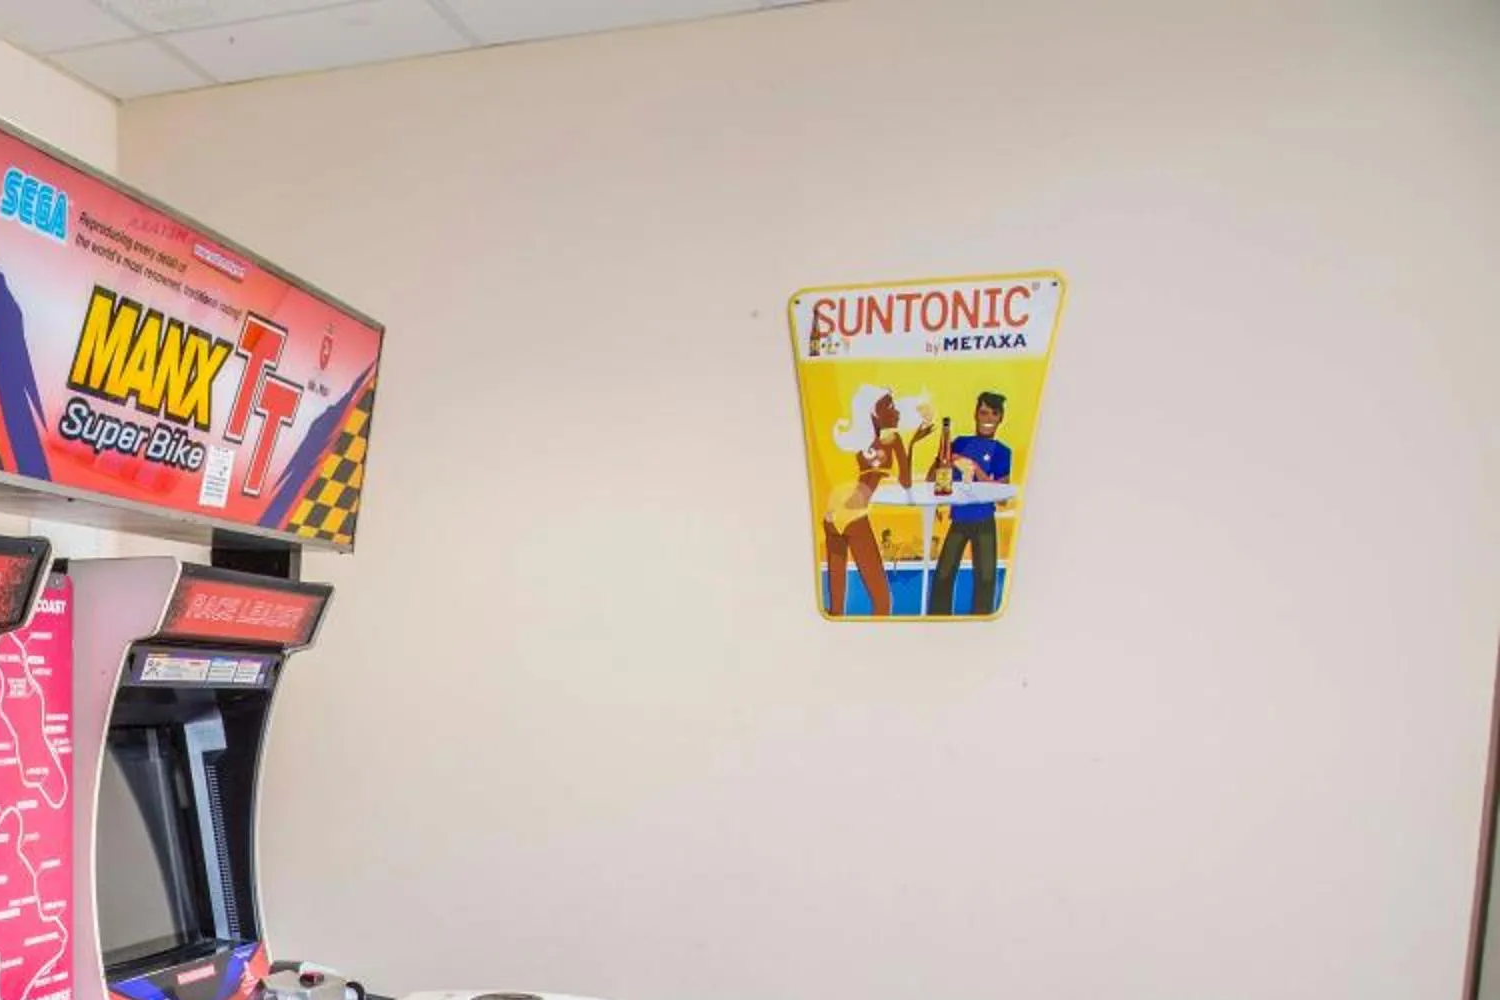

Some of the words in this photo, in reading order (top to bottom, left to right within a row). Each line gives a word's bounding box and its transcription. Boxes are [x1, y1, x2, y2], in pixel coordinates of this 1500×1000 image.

[0, 168, 70, 243] SEGA
[812, 285, 1032, 338] SUNTONIC
[943, 333, 1027, 352] METAXA
[67, 286, 231, 432] MANX
[223, 312, 304, 496] TT
[35, 599, 67, 615] COAST
